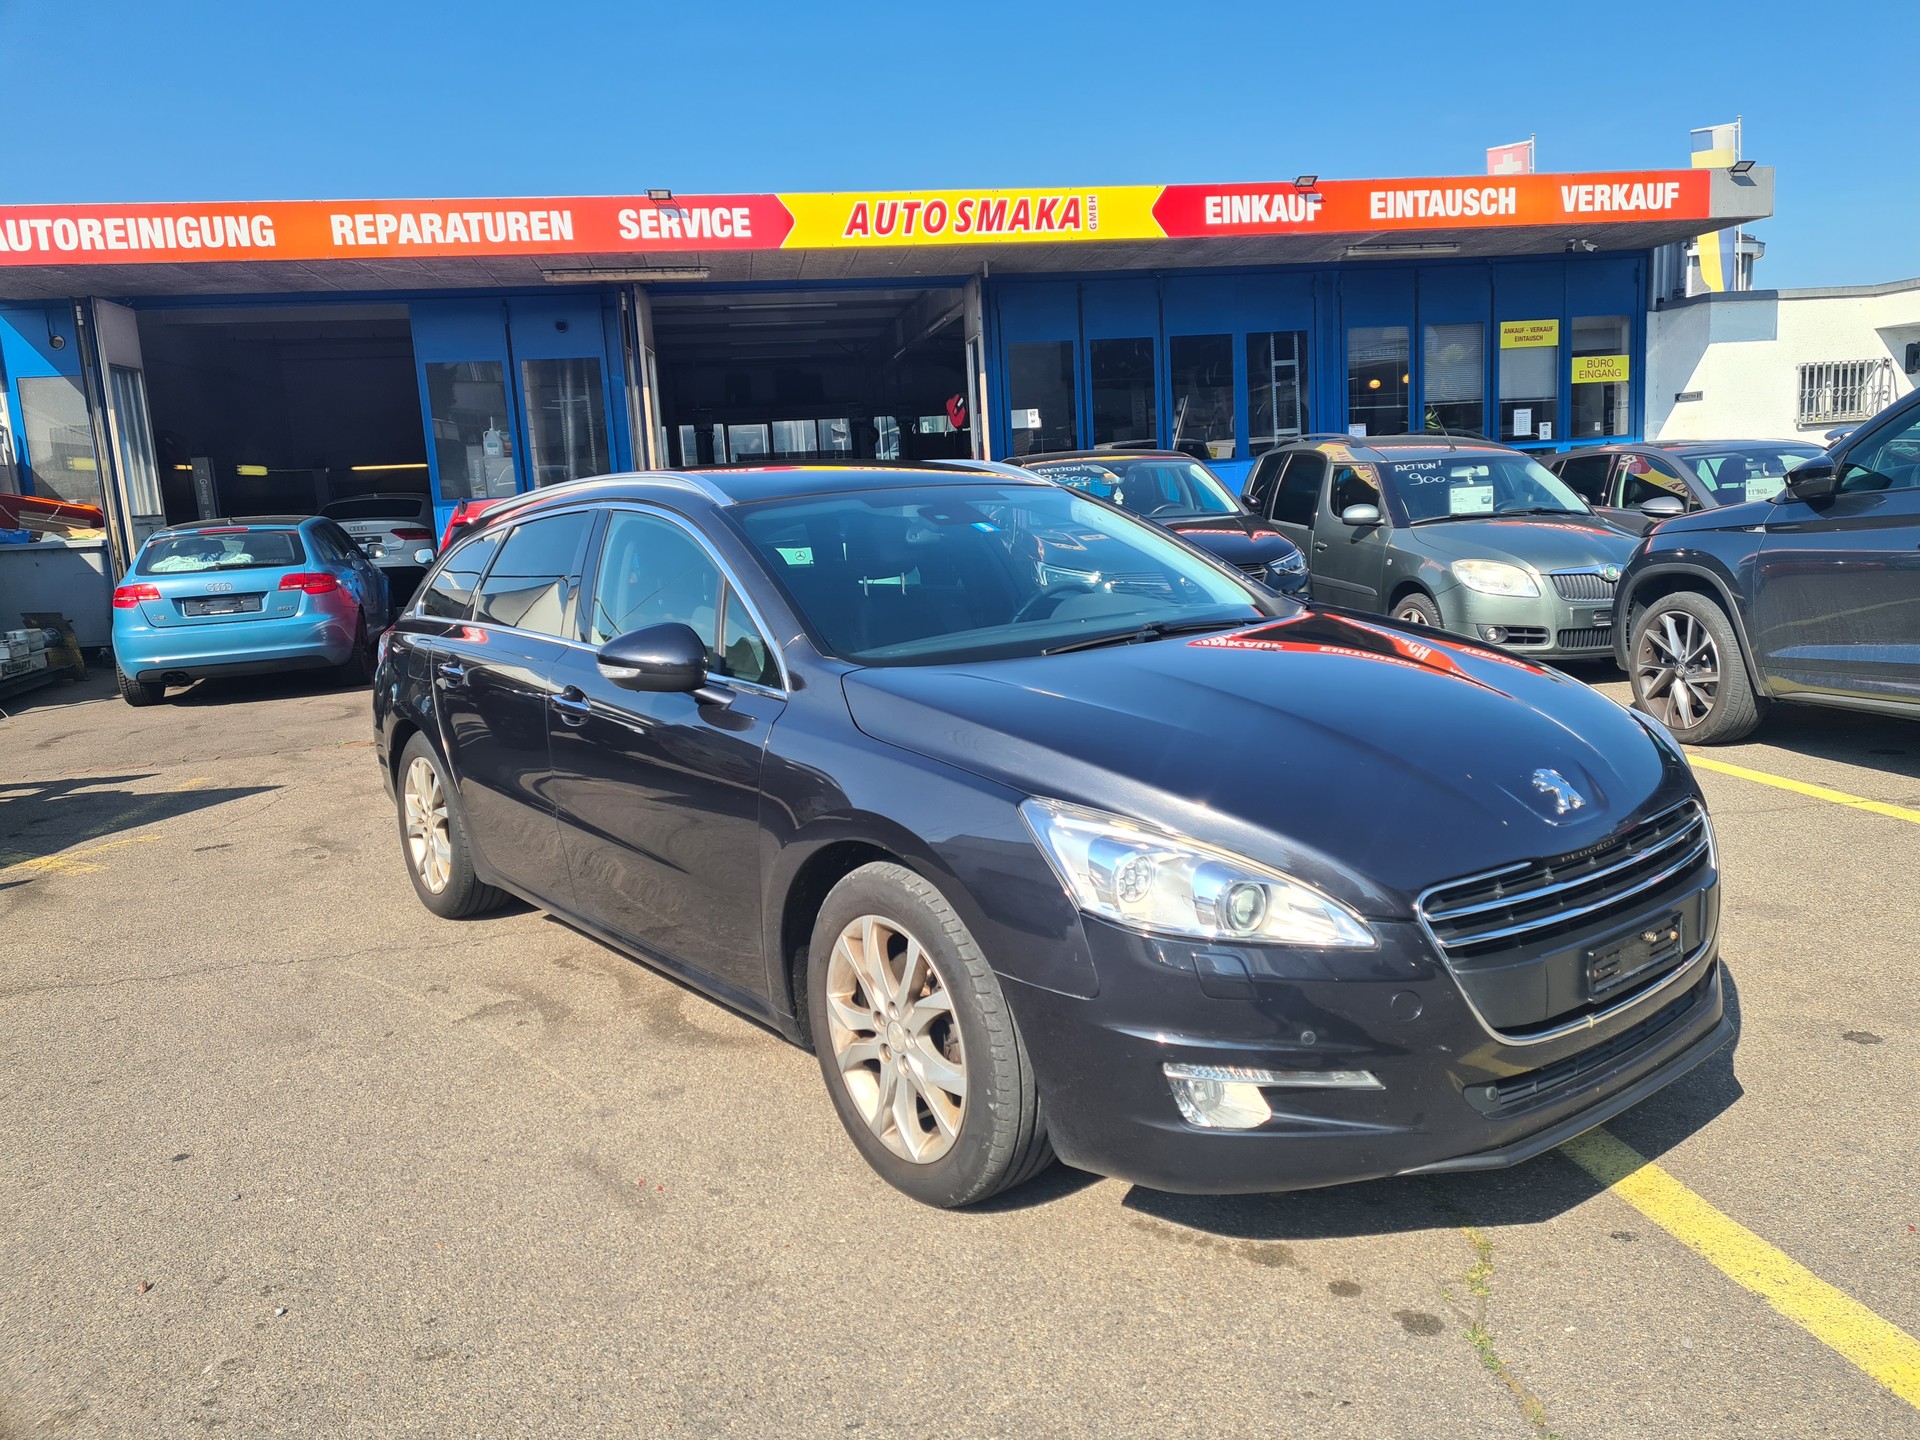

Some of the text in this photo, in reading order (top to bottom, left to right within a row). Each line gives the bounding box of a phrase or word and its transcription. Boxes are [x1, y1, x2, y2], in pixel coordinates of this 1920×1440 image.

[1087, 195, 1099, 231] GMBH
[1205, 193, 1322, 225] EINKAUF
[1369, 187, 1516, 219] EINTAUSCH
[1560, 181, 1680, 213] VERKAUF
[330, 210, 574, 246] REPARATUREN
[618, 206, 752, 240] SERVICE
[842, 195, 1082, 238] AUTO SMAKA
[1514, 335, 1544, 343] EINTAUSCH
[1529, 325, 1554, 333] VERKAUF
[1578, 368, 1622, 379] EINGANG
[1586, 357, 1615, 369] BÜRO
[1561, 835, 1617, 863] PEUGEOT
